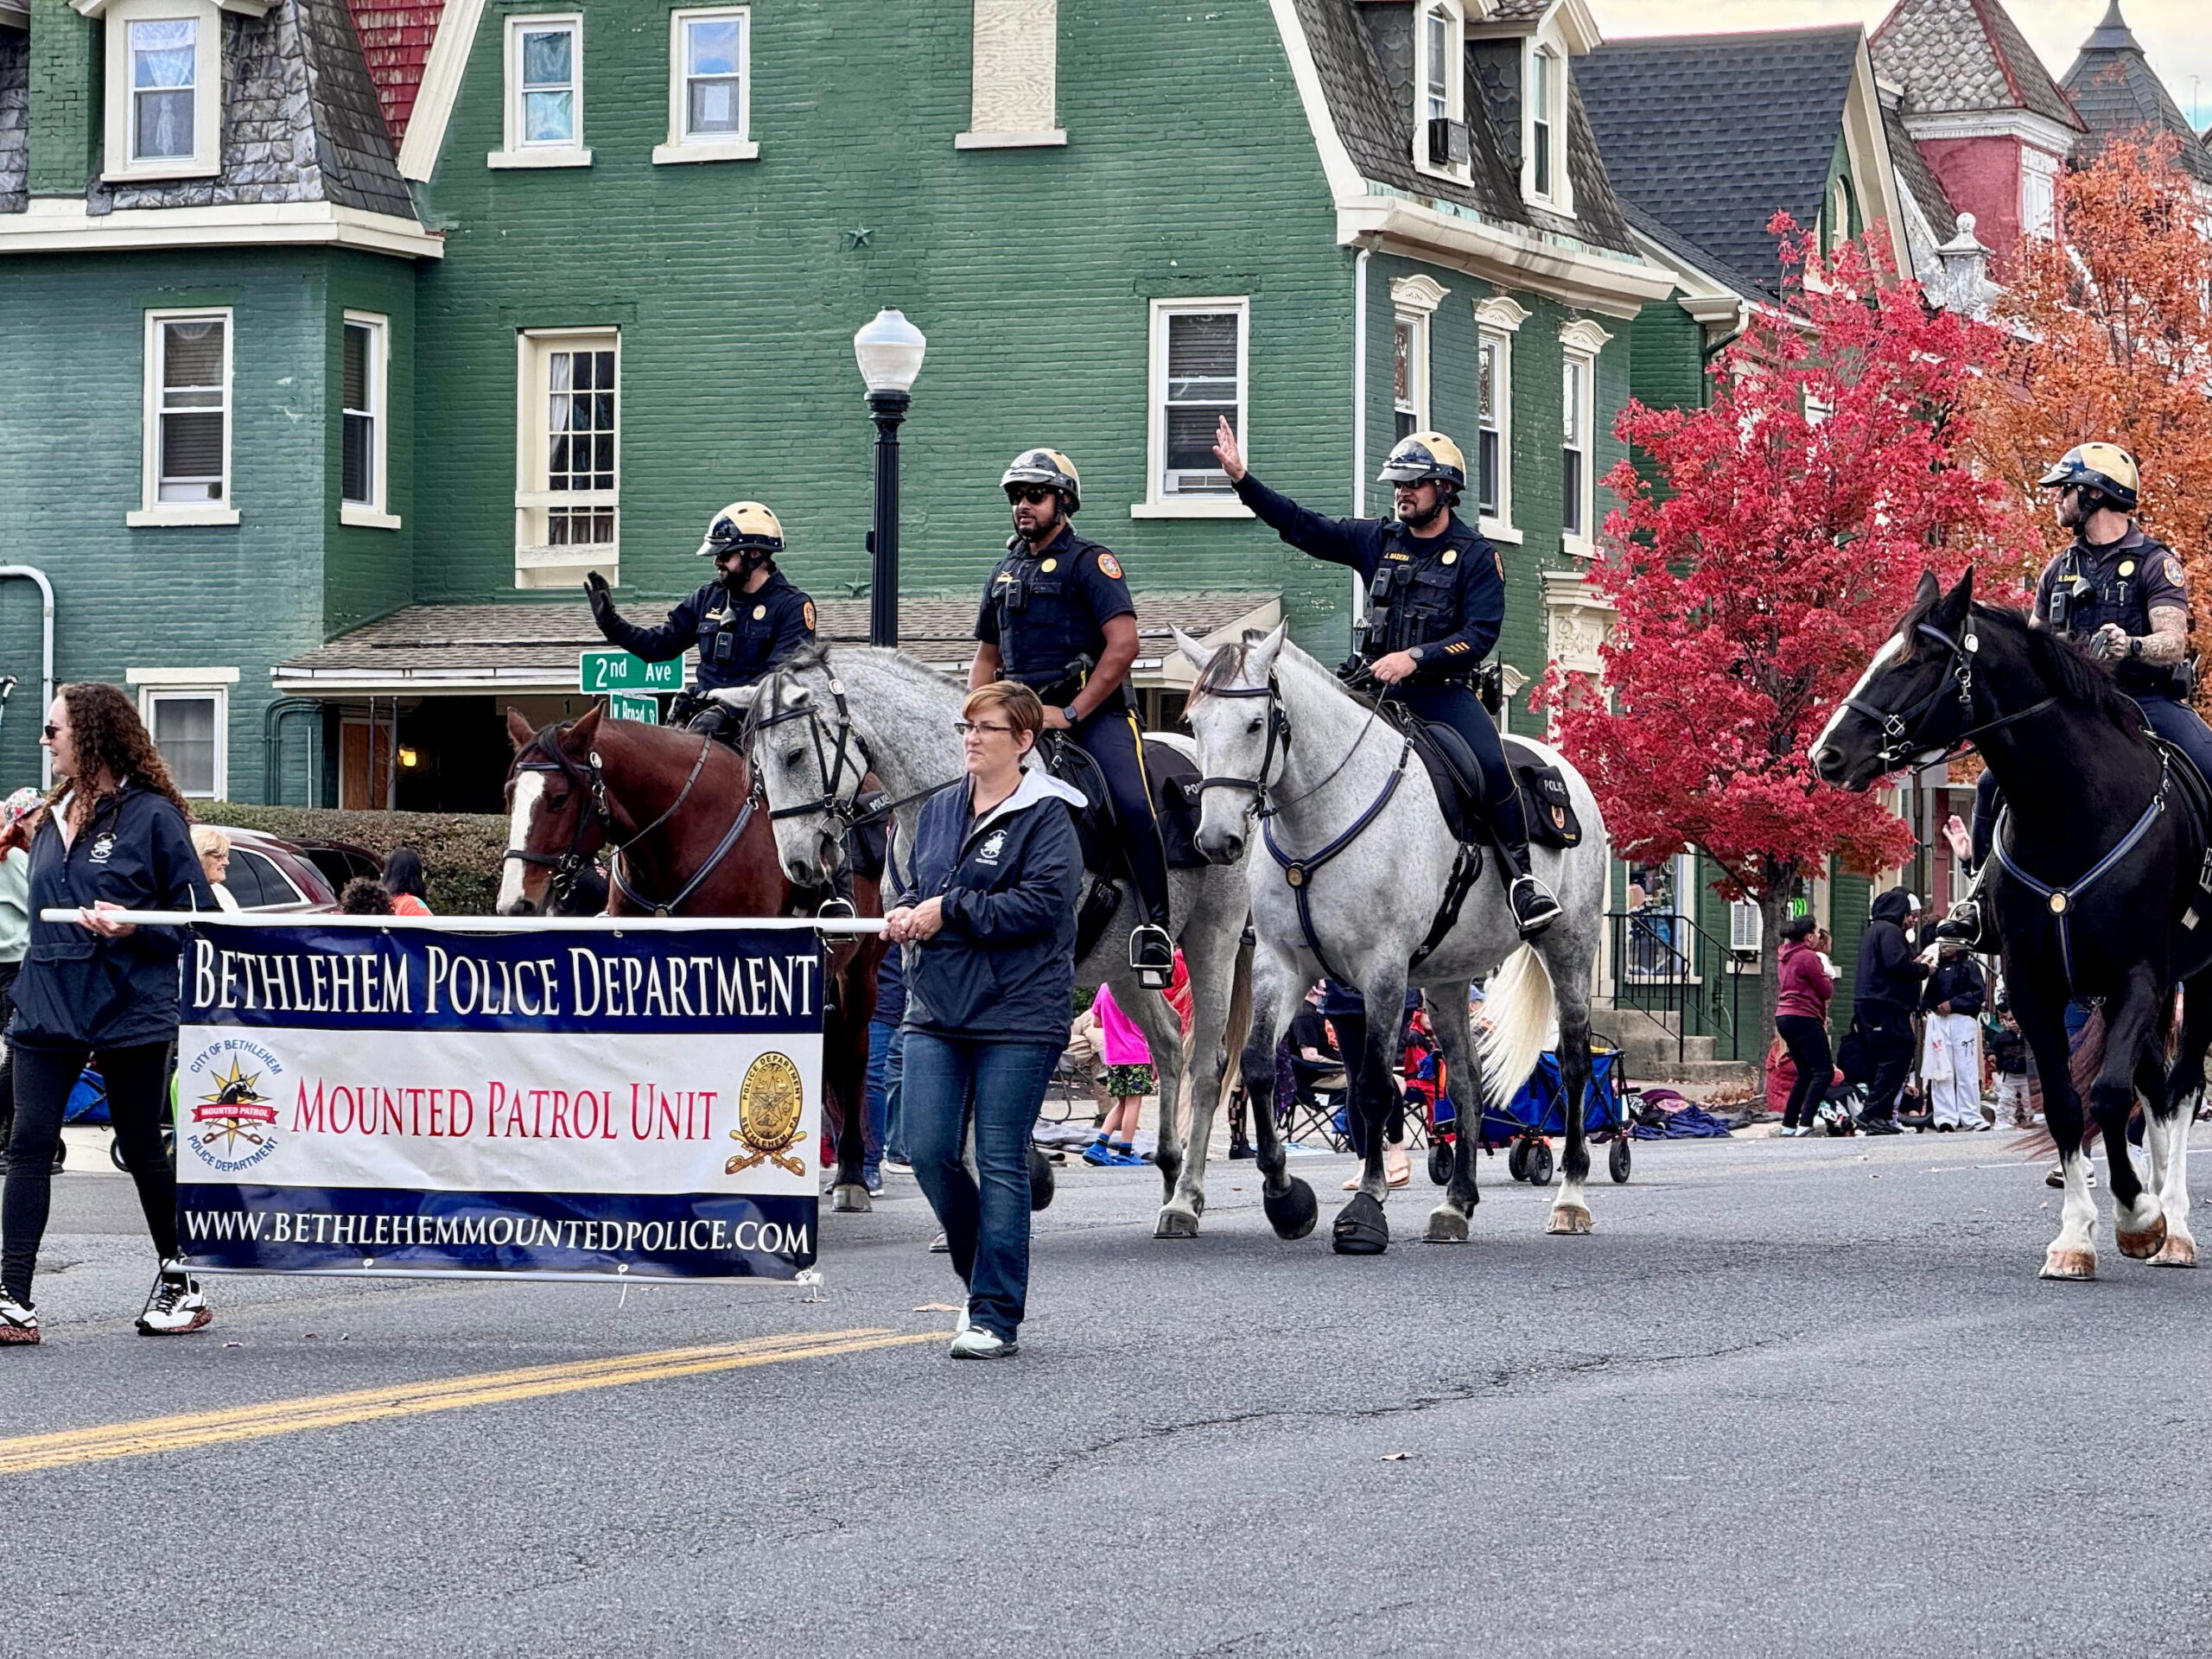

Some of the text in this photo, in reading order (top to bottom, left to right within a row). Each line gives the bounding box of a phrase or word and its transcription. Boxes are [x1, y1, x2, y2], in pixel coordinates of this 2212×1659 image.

[595, 658, 672, 688] 2nd Ave
[193, 938, 818, 1017] BETHLEHEM POLICE DEPARTMENT
[189, 1039, 283, 1077] CITY OF BETHLEHEM
[742, 1055, 802, 1102] POLICE DEPARTMENT
[200, 1106, 270, 1118] MOUNTED PATROL
[290, 1076, 719, 1141] MOUNTED PATROL UNIT
[789, 1116, 798, 1130] PA
[187, 1135, 279, 1173] POLICE DEPARTMENT
[184, 1210, 811, 1255] WWW.BETHLEHEMMOUNTEDPOLICE.COM
